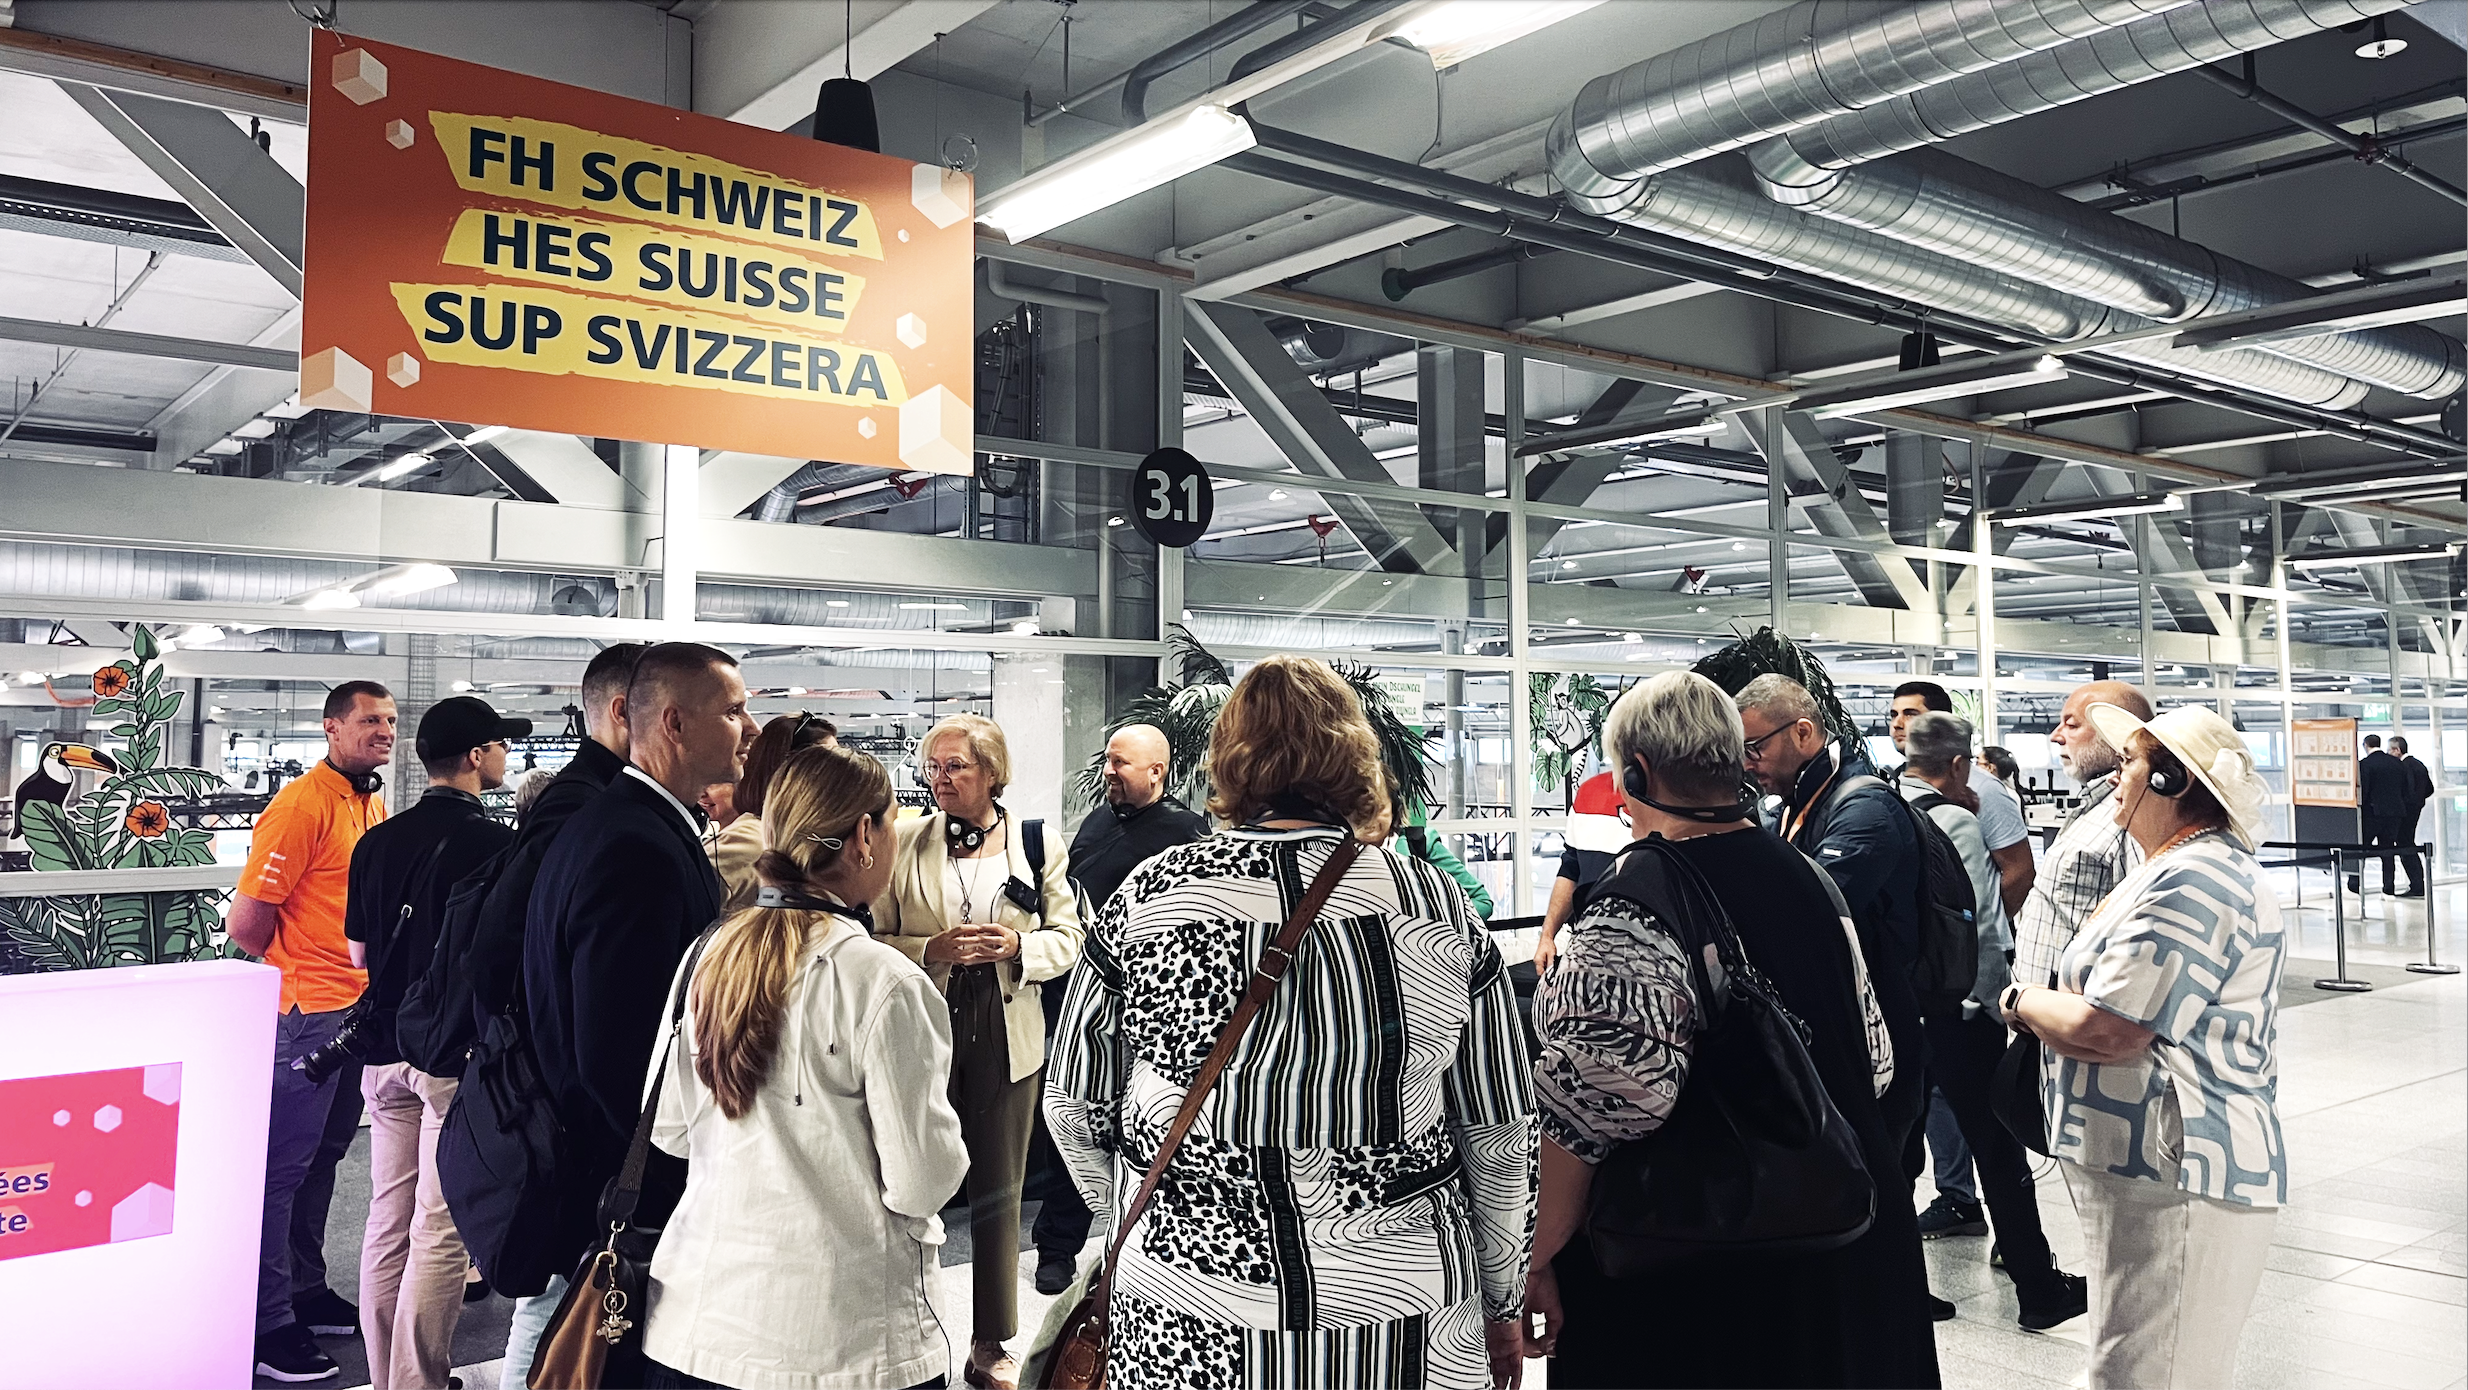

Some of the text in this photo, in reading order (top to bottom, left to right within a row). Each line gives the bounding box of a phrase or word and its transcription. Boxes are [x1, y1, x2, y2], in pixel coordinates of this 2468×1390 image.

[468, 126, 859, 248] FH SCHWEIZ
[483, 213, 845, 320] HES SUISSE
[424, 291, 888, 401] SUP SVIZZERA
[1146, 469, 1198, 523] 3.1
[1364, 918, 1380, 948] TODAY
[1375, 949, 1391, 998] BEAUTIFUL
[1293, 1297, 1304, 1328] TODAY
